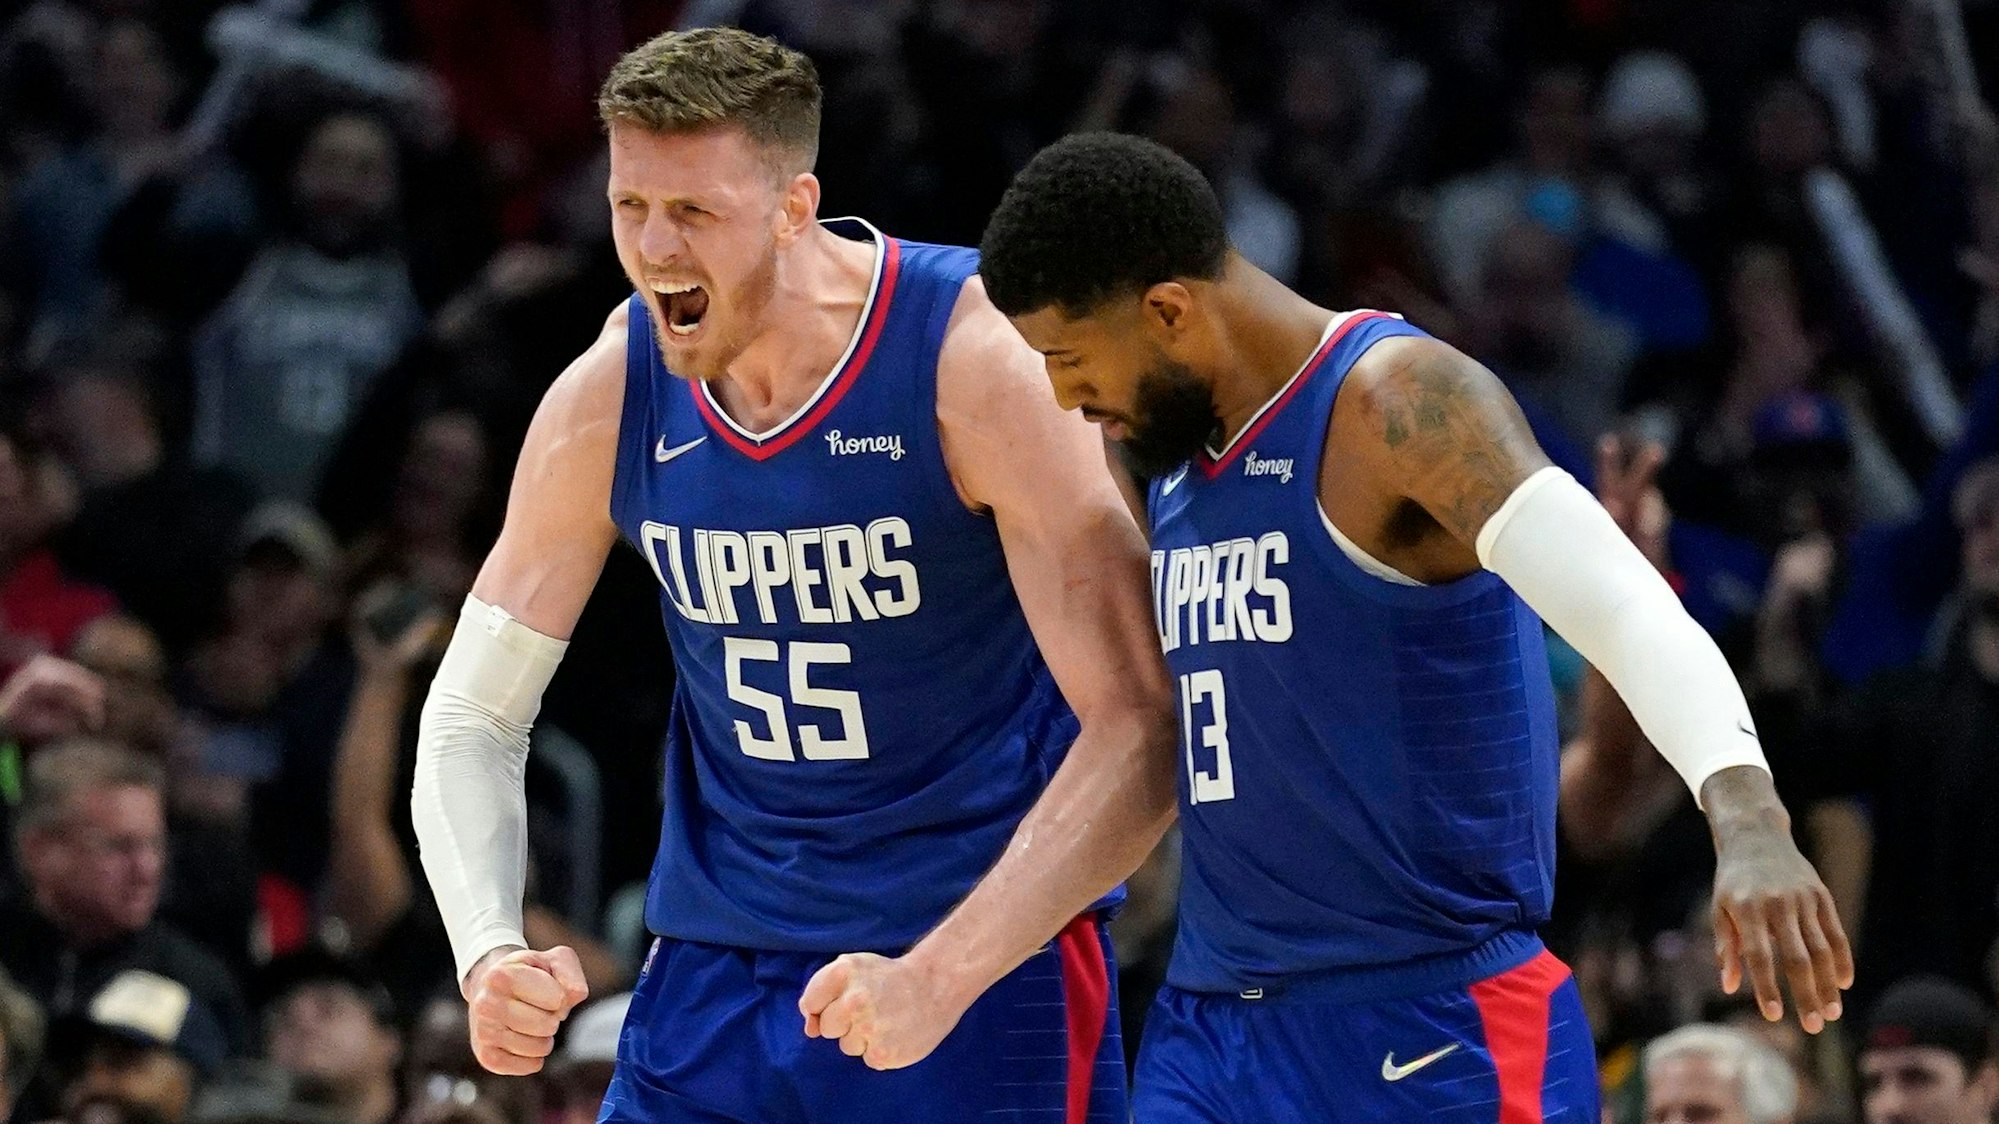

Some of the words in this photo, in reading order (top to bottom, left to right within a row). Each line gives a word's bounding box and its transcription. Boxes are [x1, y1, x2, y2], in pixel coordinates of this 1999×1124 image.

[825, 429, 905, 460] honey
[1244, 451, 1293, 484] honey
[640, 516, 921, 624] CLIPPERS
[723, 636, 870, 762] 55
[1180, 669, 1235, 806] 13
